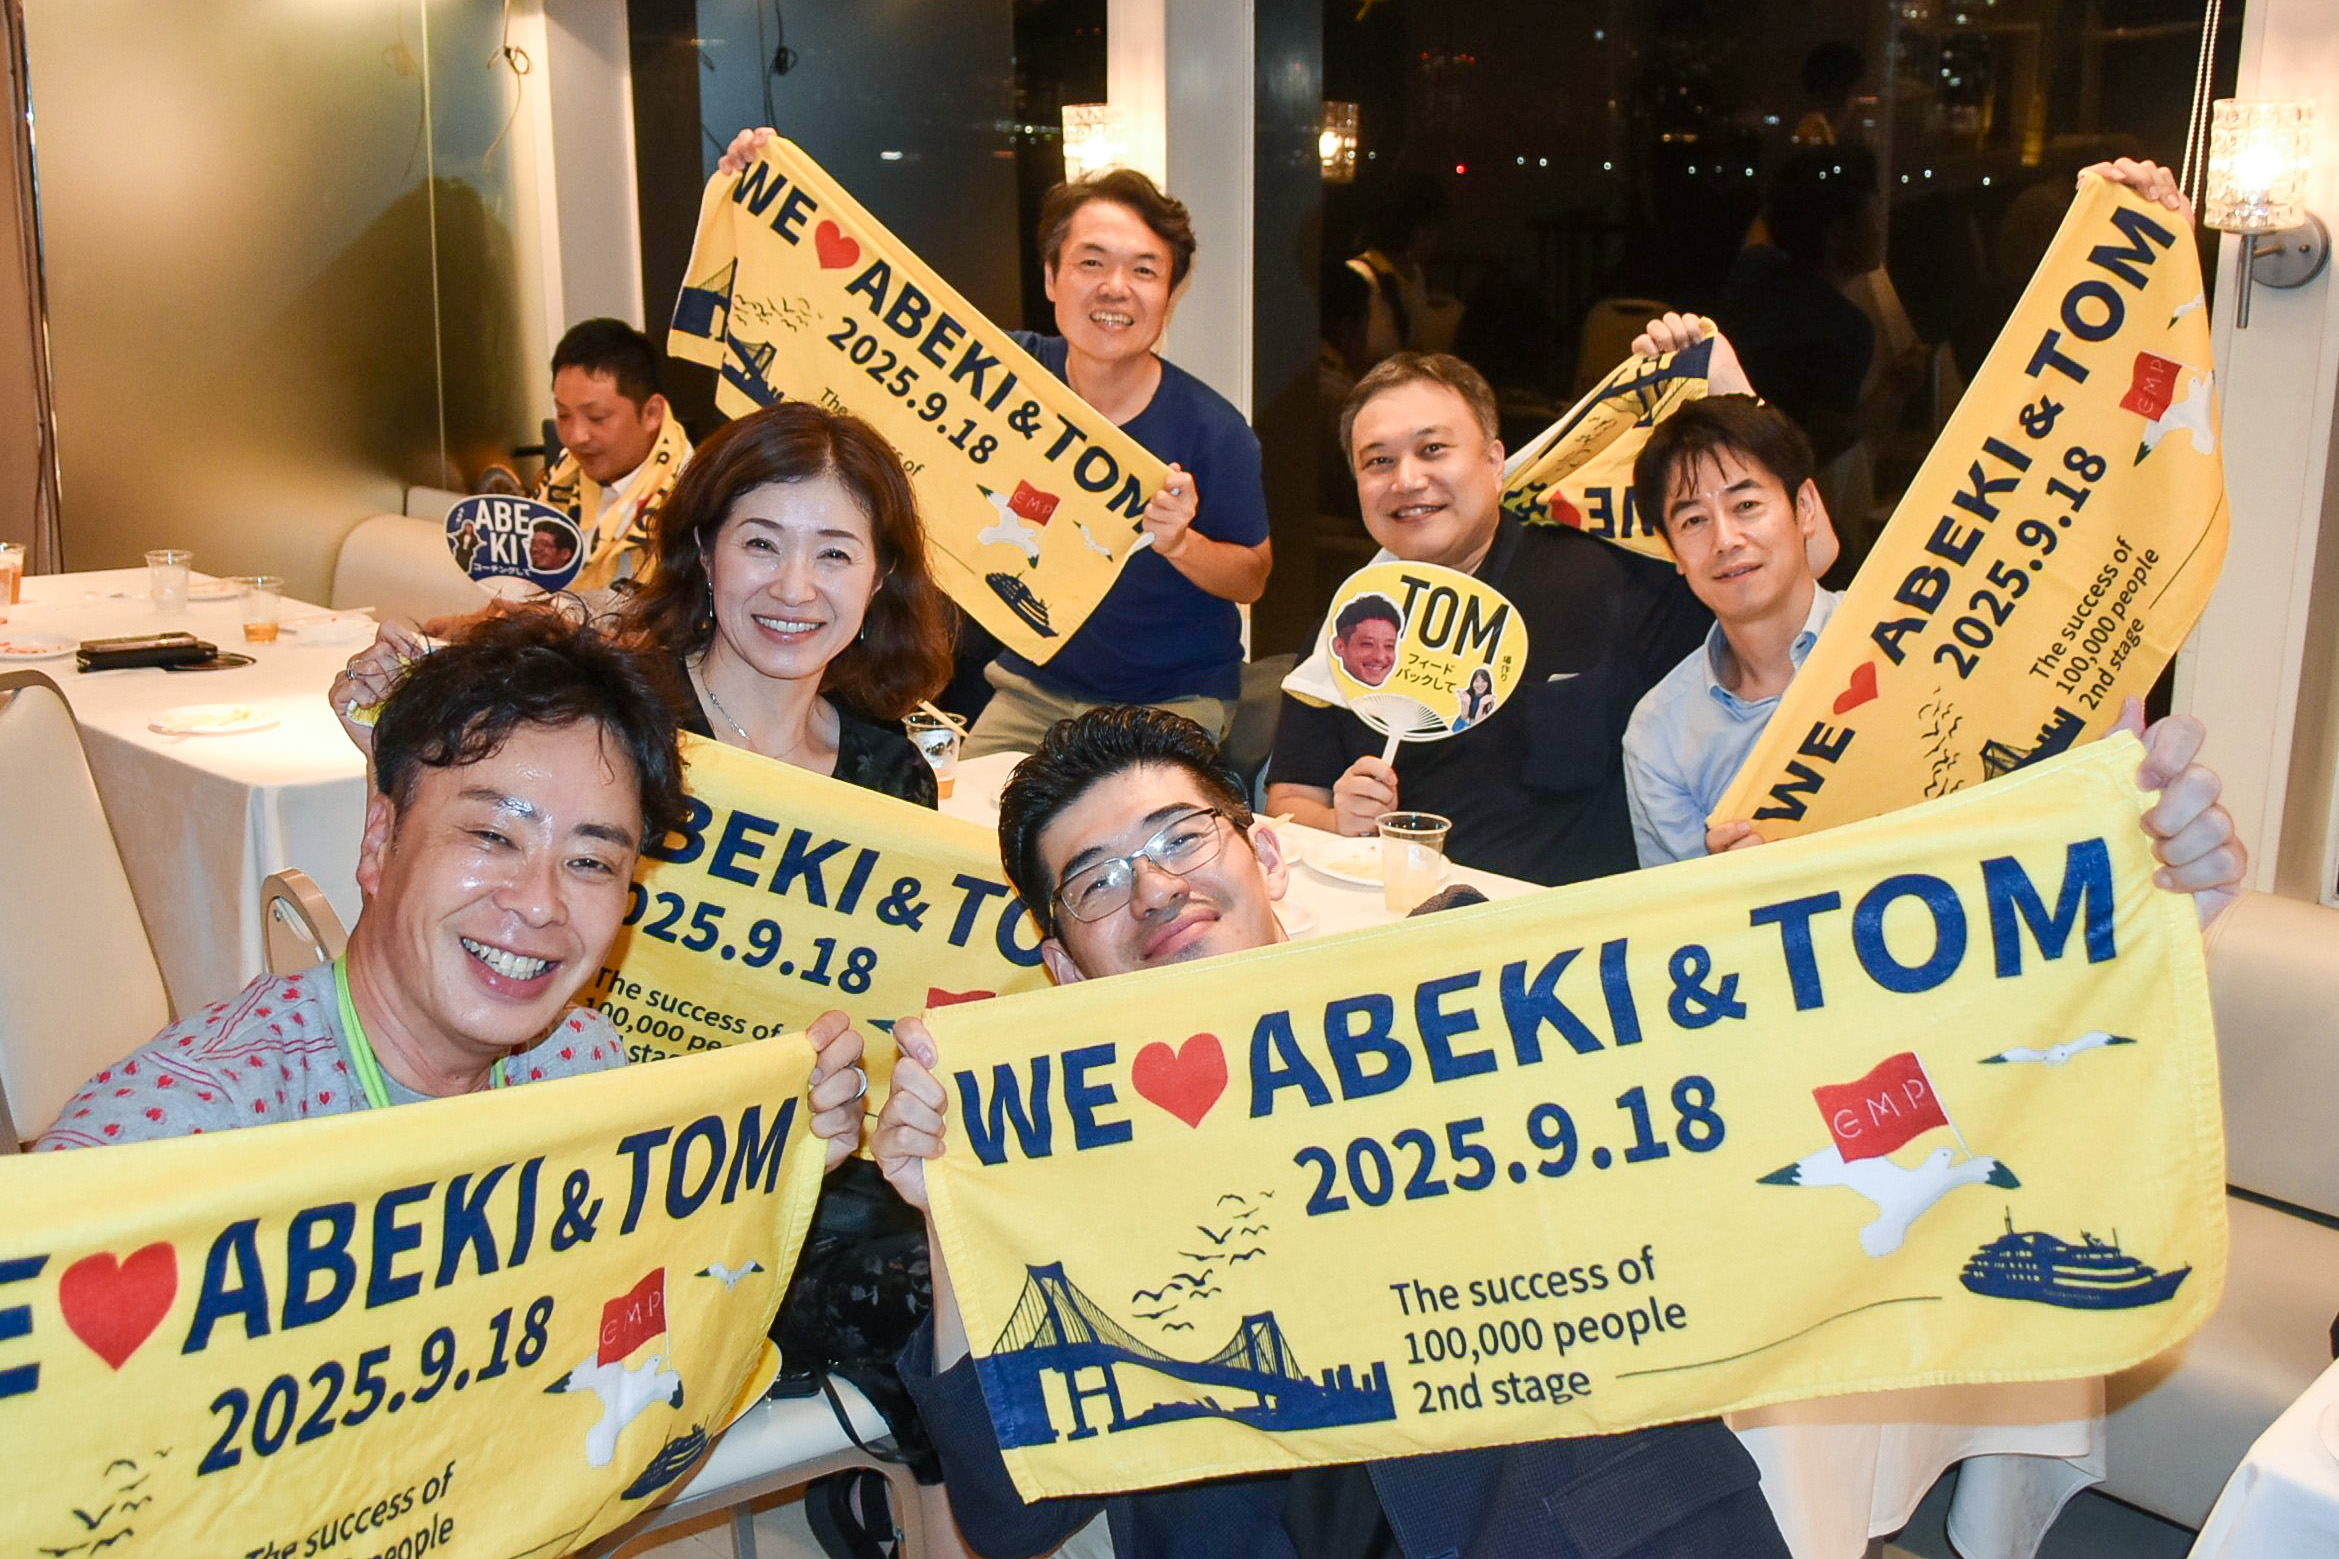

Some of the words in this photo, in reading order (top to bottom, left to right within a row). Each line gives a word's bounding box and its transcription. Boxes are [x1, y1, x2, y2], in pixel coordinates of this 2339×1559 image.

[2025, 206, 2176, 384] TOM
[732, 160, 818, 247] WE
[843, 258, 1018, 412] ABEKI
[1007, 400, 1042, 440] &
[1044, 413, 1151, 535] TOM
[827, 317, 999, 464] 2025.9.18
[820, 386, 849, 415] The
[2018, 395, 2066, 440] &
[473, 498, 531, 537] ABE
[489, 531, 519, 566] KI
[1871, 437, 2033, 667] ABEKI
[1933, 446, 2107, 680] 2025.9.18
[1400, 574, 1510, 665] TOM
[2028, 642, 2068, 679] The
[2061, 563, 2119, 642] success
[2113, 534, 2133, 564] of
[2055, 616, 2117, 695] 100,000
[2110, 548, 2160, 622] people
[1395, 667, 1457, 694] バックして
[1408, 652, 1456, 676] フィード
[2078, 667, 2116, 711] 2nd
[2109, 617, 2145, 673] stage
[1752, 721, 1856, 822] WE
[655, 793, 881, 916] BEKI
[875, 876, 931, 933] &
[947, 873, 1045, 968] TO
[645, 988, 748, 1035] success
[953, 1042, 1134, 1167] WE
[1249, 937, 1643, 1119] ABEKI
[1667, 944, 1747, 1030] &
[1749, 837, 2118, 1012] TOM
[1293, 1075, 1726, 1217] 2025.9.18
[180, 1155, 546, 1356] ABEKI
[550, 1168, 604, 1253] &
[616, 1096, 799, 1236] TOM
[1389, 1279, 1460, 1316] The
[1469, 1264, 1609, 1307] success
[1618, 1244, 1655, 1285] of
[1404, 1317, 1543, 1365] 100,000
[1553, 1296, 1687, 1357] people
[196, 1295, 555, 1477] 2025.9.18
[1413, 1372, 1483, 1414] 2nd
[1491, 1372, 1592, 1406] stage
[303, 1486, 416, 1559] success
[421, 1459, 456, 1505] of
